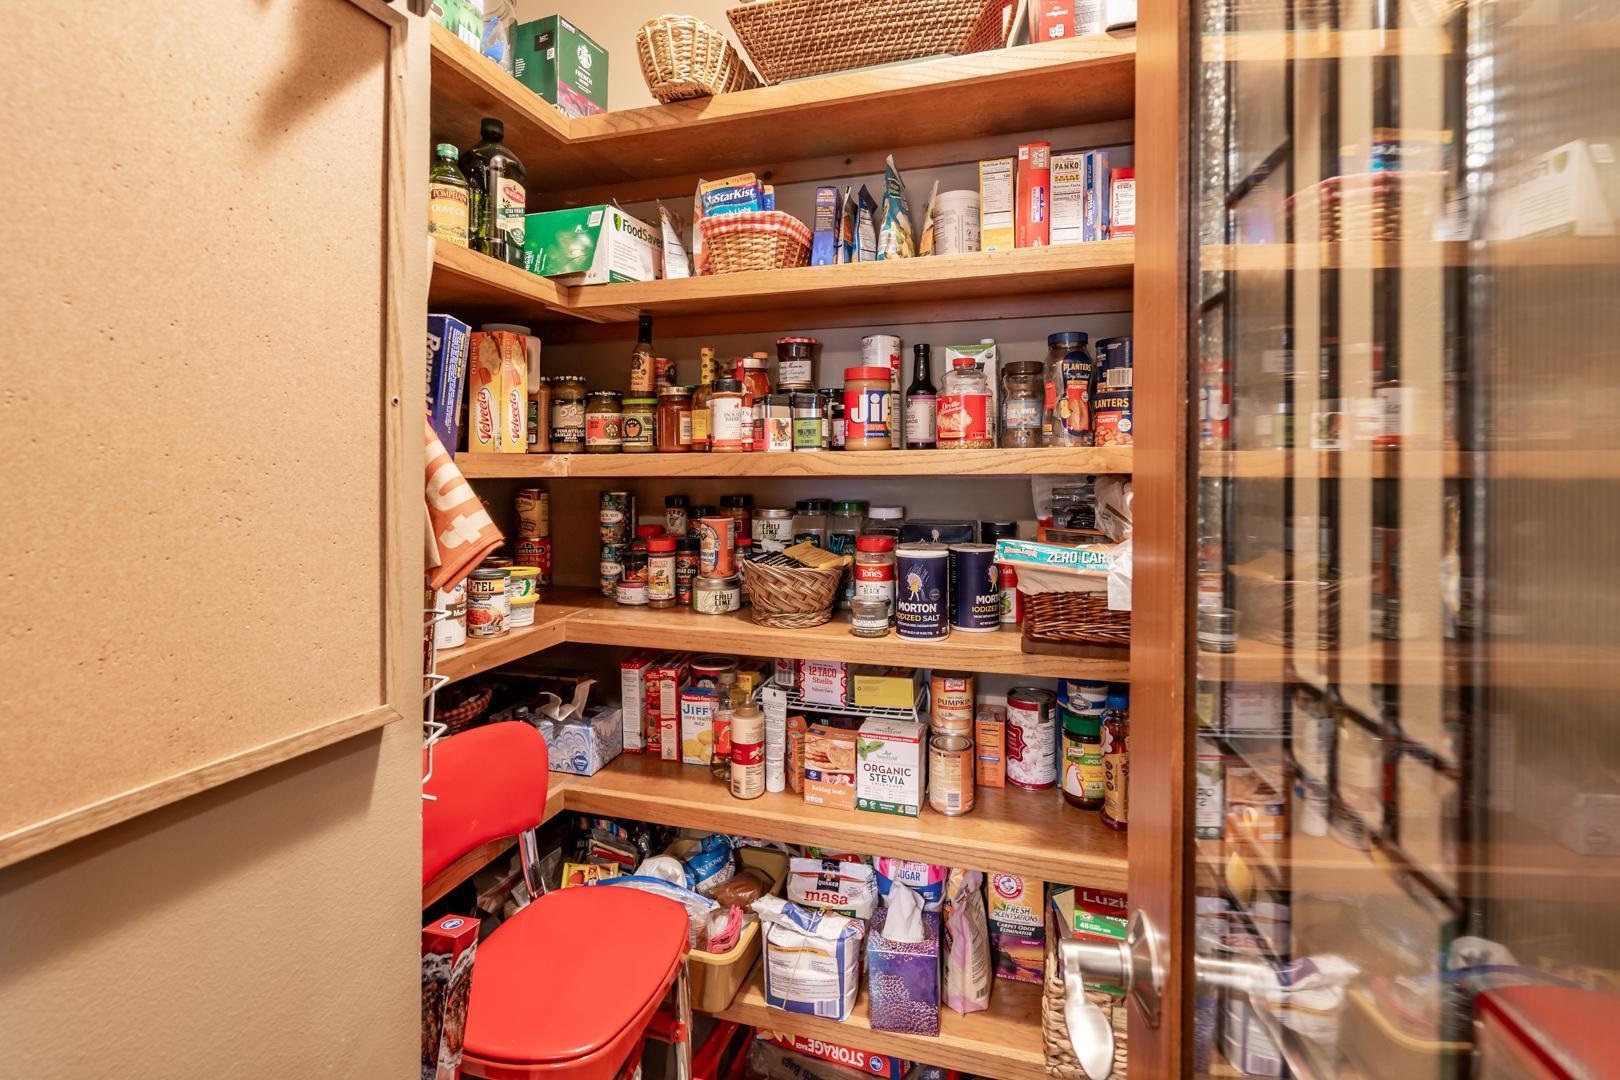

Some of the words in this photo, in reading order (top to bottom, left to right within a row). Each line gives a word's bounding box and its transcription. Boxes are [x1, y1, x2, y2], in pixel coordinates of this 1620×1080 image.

[1046, 9, 1068, 17] original
[1055, 162, 1079, 170] PANKO
[433, 190, 467, 203] POMPEIAN
[714, 188, 755, 204] StarKist
[432, 204, 453, 214] OLIVE
[622, 219, 662, 249] FoodSaver
[1064, 363, 1092, 372] PLANTERS
[850, 393, 891, 423] Jif
[479, 390, 492, 440] Velveeta
[510, 392, 519, 439] Velveeta
[1047, 552, 1078, 564] ZERO
[862, 568, 883, 578] Tone's
[898, 603, 937, 612] MORTON
[896, 613, 921, 622] IODIZED
[922, 614, 940, 622] SALT
[809, 666, 818, 675] 12
[818, 667, 837, 678] TACO
[937, 698, 972, 706] PUMPKIN
[682, 704, 716, 714] JIFFY
[864, 764, 912, 776] ORGANIC
[870, 773, 904, 785] STEVIA
[818, 880, 838, 888] QUAKER
[804, 890, 848, 905] masa
[1006, 903, 1030, 915] FRESH
[994, 910, 1039, 922] SCENTSATIONS
[1000, 927, 1033, 937] ELIMINATOR
[808, 1039, 864, 1067] STORAGE
